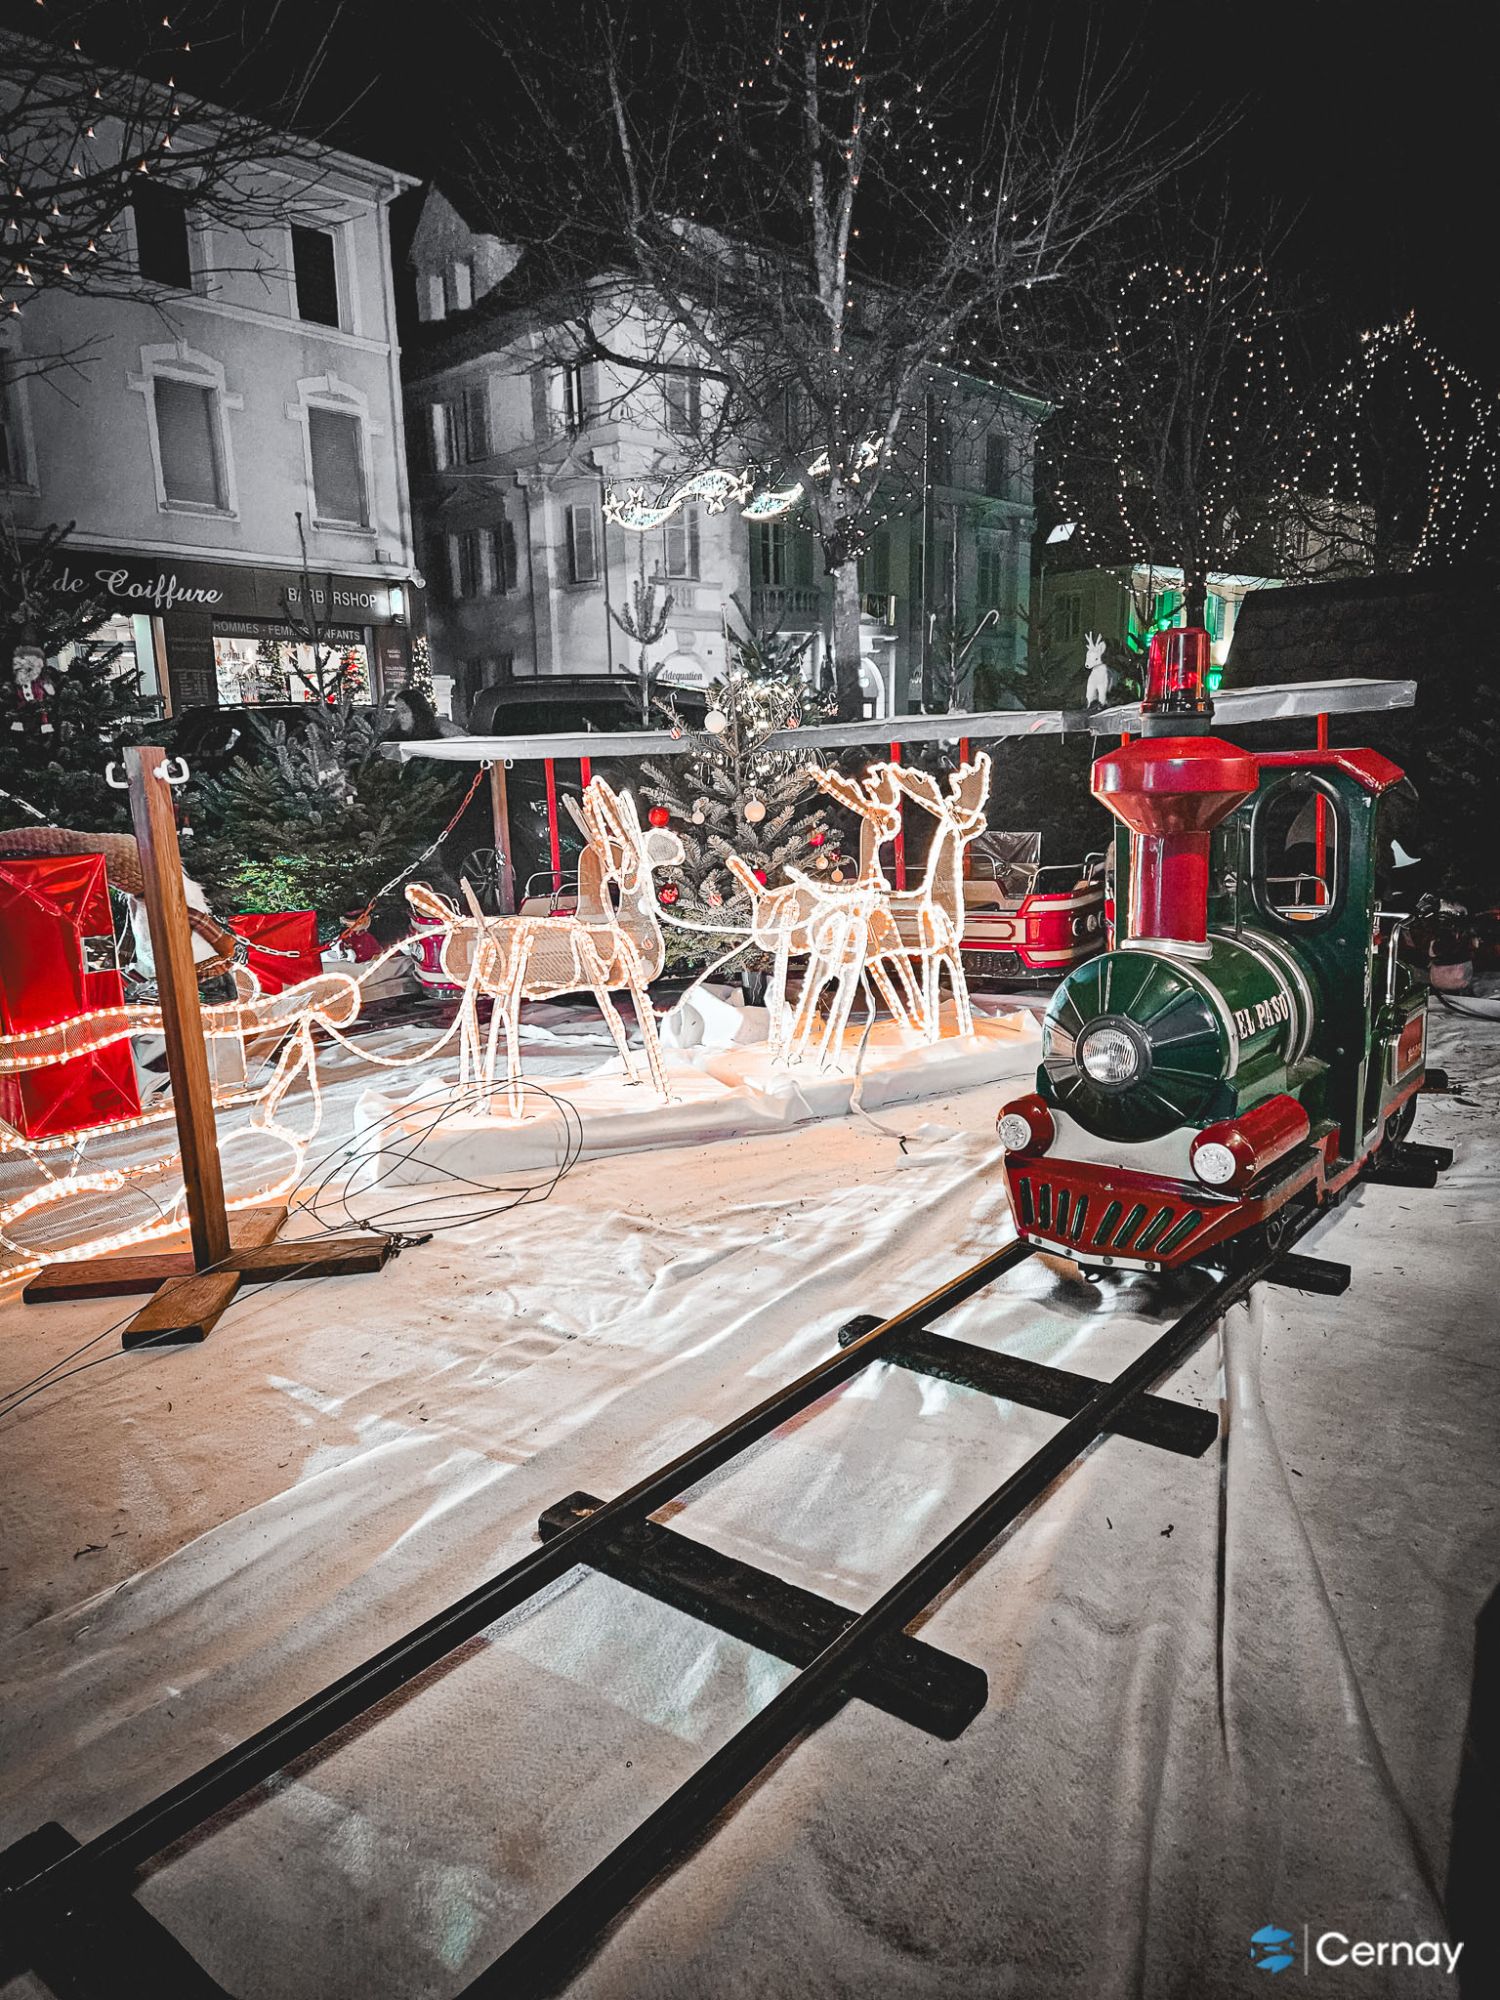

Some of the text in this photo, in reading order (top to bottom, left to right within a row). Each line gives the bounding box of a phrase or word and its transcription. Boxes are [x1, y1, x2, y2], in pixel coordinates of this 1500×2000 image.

[50, 567, 223, 609] de Coiffure
[288, 587, 377, 608] BRBRSHOP
[213, 620, 260, 634] HOMMES
[268, 624, 309, 637] FEMS
[1232, 993, 1289, 1040] EL PASO
